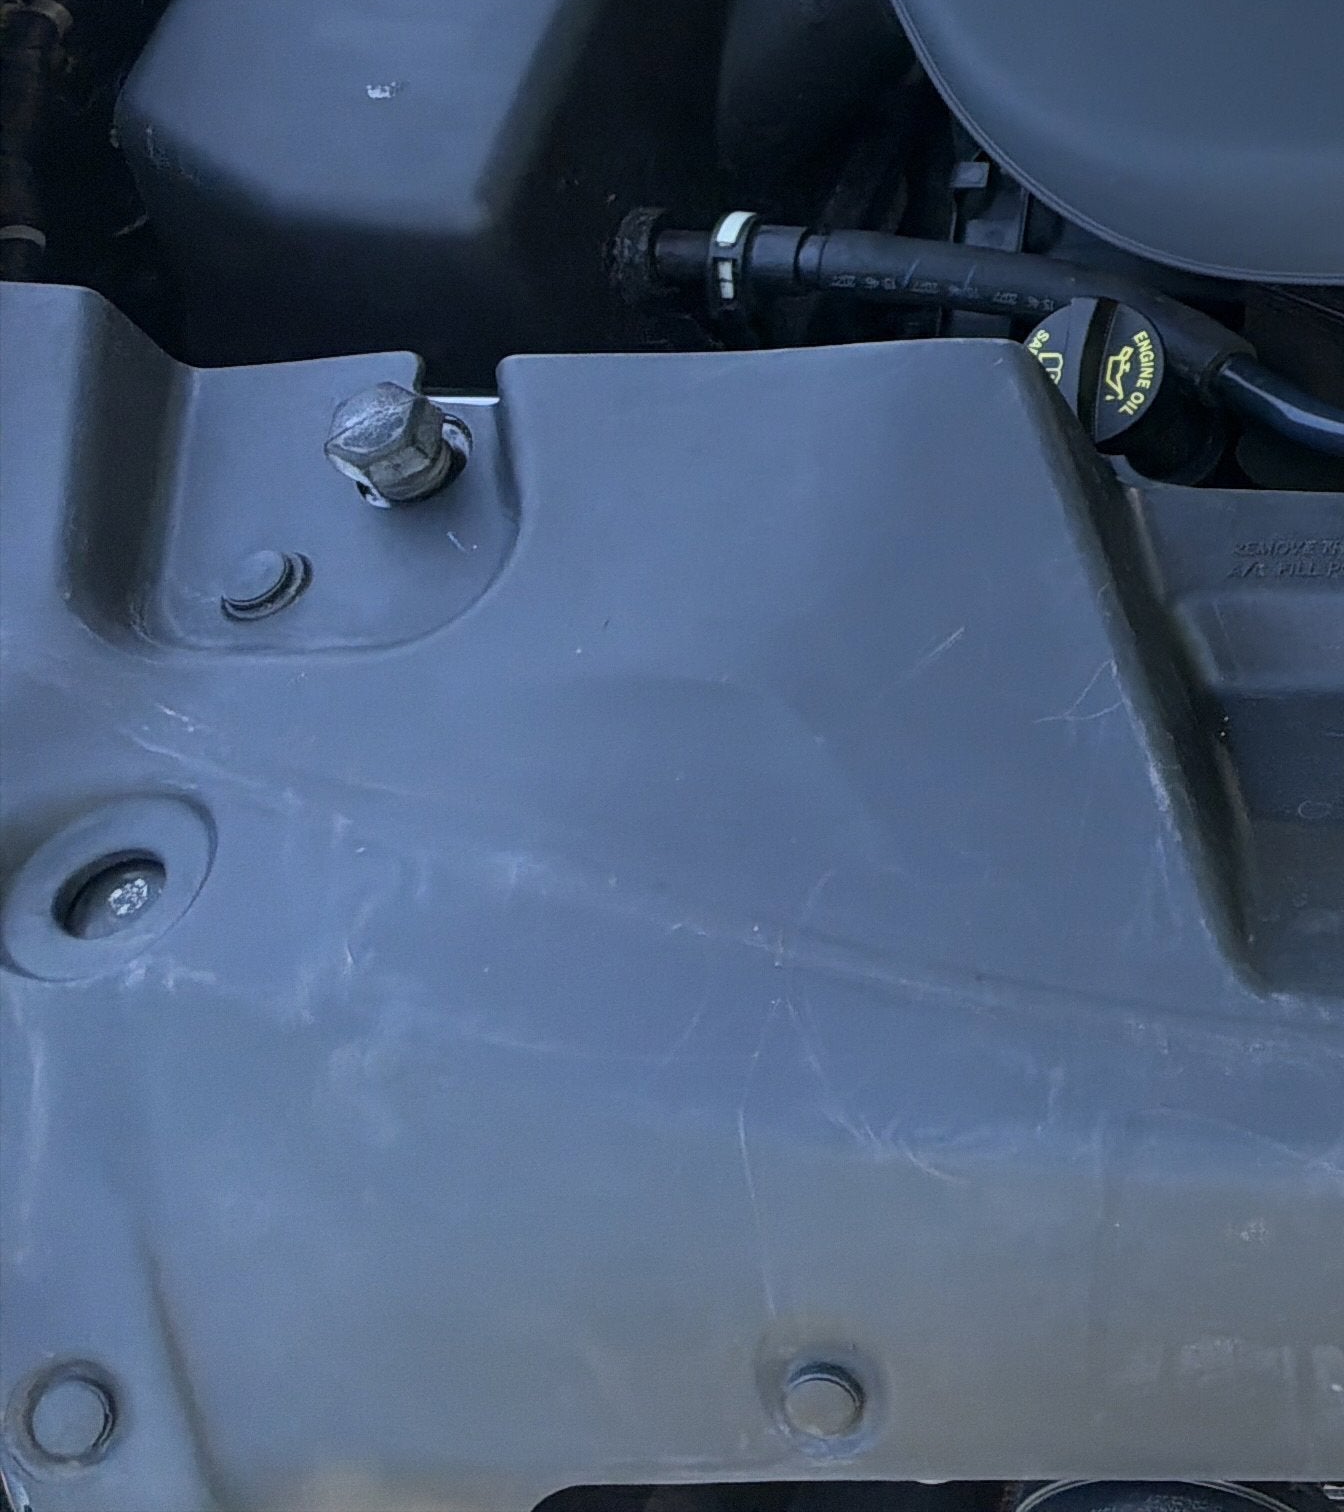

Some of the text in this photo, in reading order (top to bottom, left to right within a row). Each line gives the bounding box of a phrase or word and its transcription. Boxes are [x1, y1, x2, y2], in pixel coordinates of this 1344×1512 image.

[1118, 330, 1155, 416] ENGINE OIL
[1232, 540, 1316, 557] REMOVE
[1279, 560, 1317, 576] FILL
